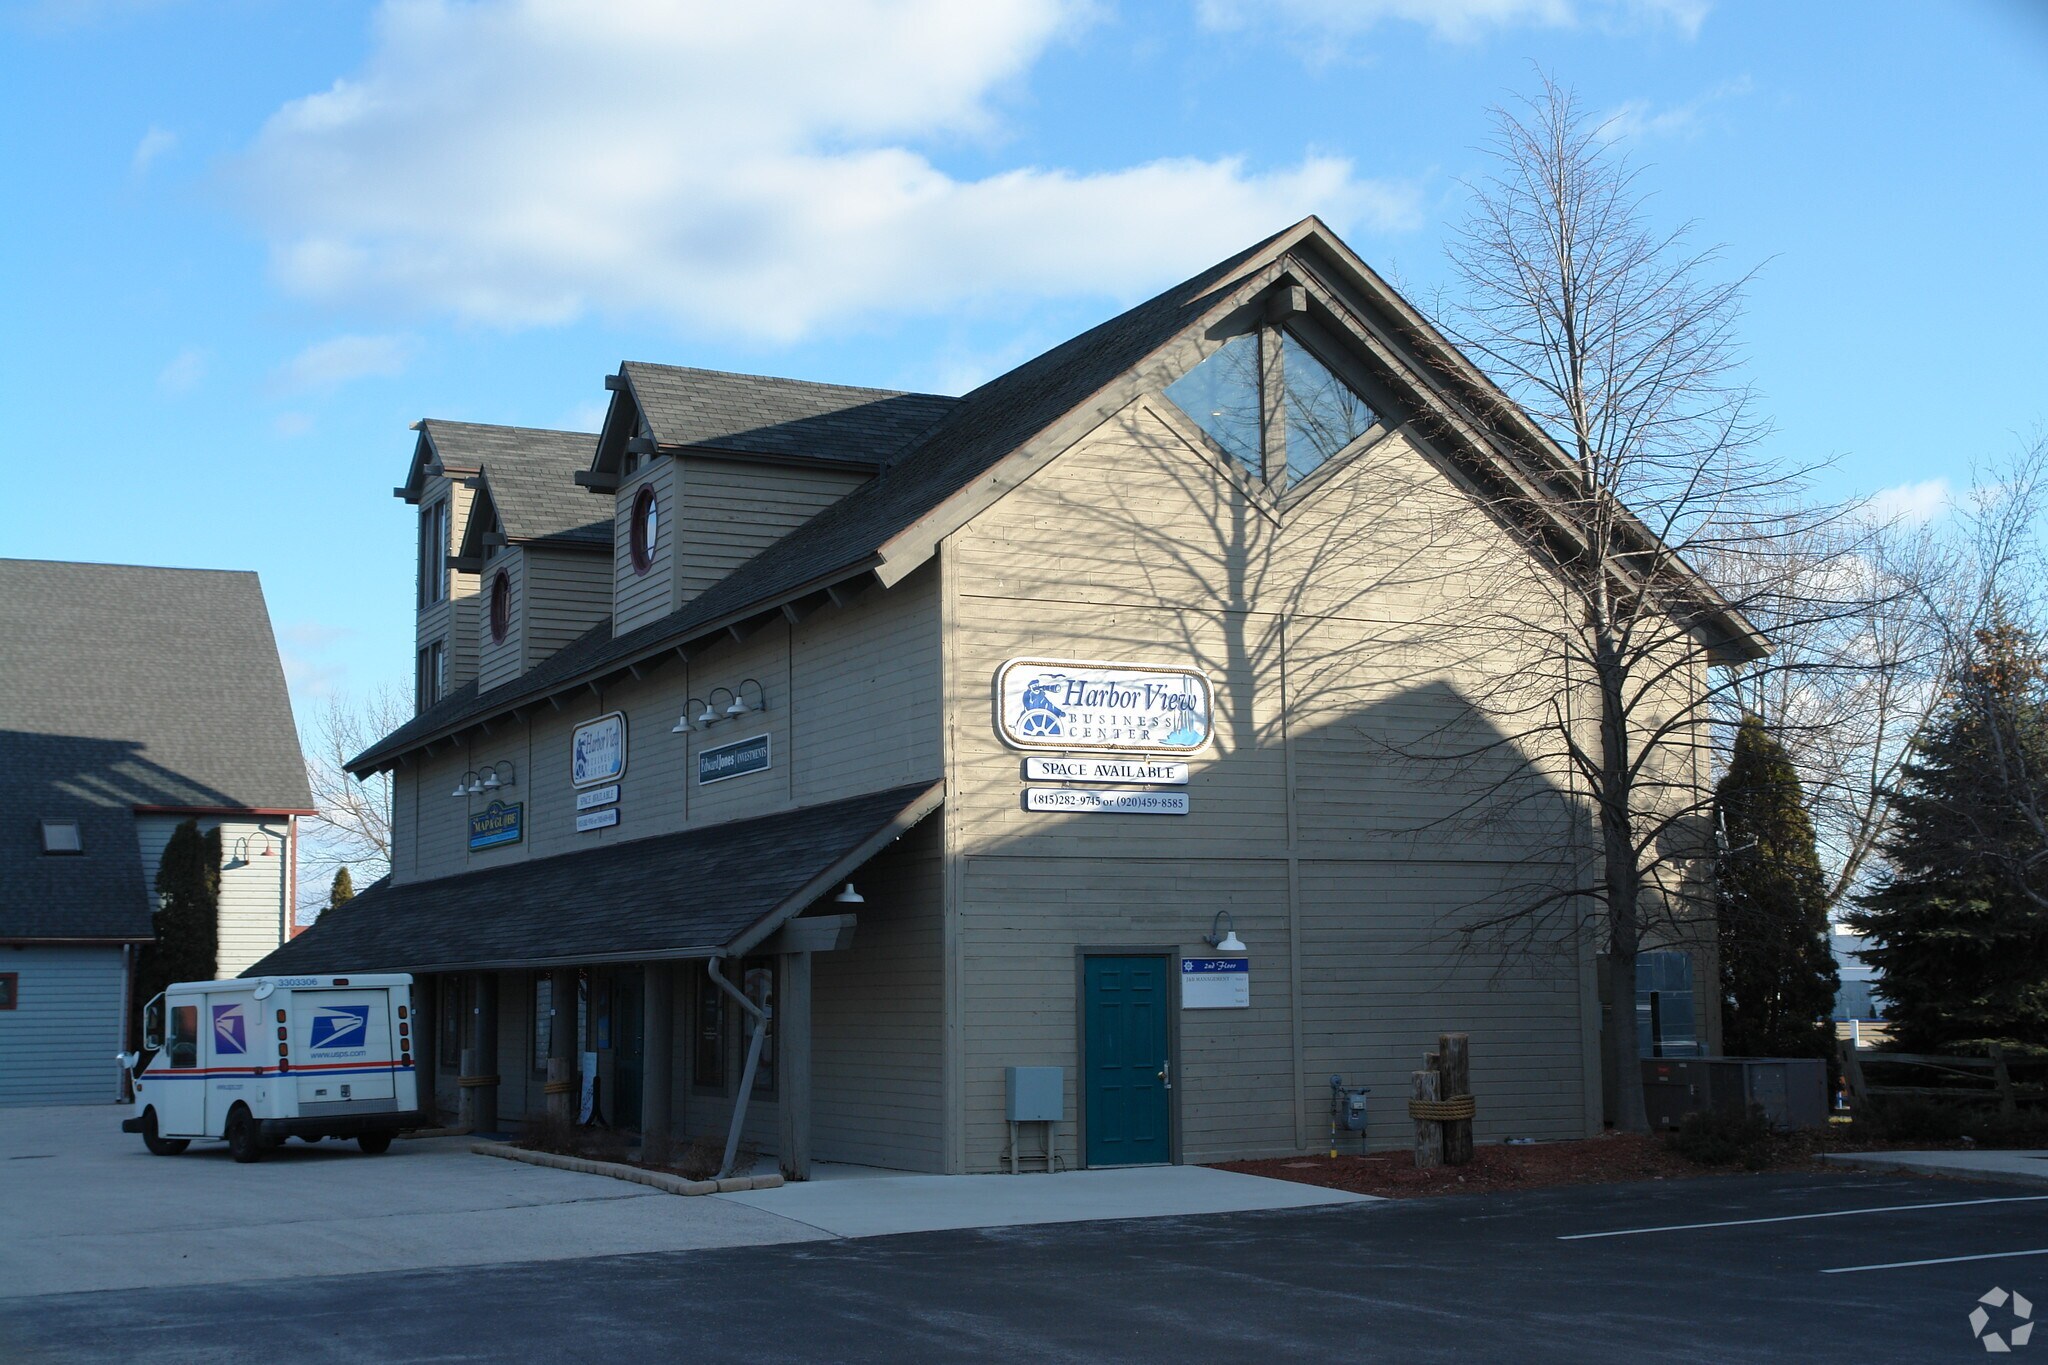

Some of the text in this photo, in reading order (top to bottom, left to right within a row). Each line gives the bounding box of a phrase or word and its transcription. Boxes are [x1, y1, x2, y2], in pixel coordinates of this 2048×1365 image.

[1062, 680, 1197, 711] Harbor View
[1069, 713, 1172, 728] BUSINESS
[1069, 727, 1151, 740] CENTER
[1042, 762, 1175, 779] SPACE AVAILABLE
[1033, 794, 1184, 809] (815)282-9745 or (920)459-8585
[1204, 961, 1237, 971] 2nd Floor
[278, 978, 318, 987] 3303306
[310, 1050, 367, 1060] www.usps.com
